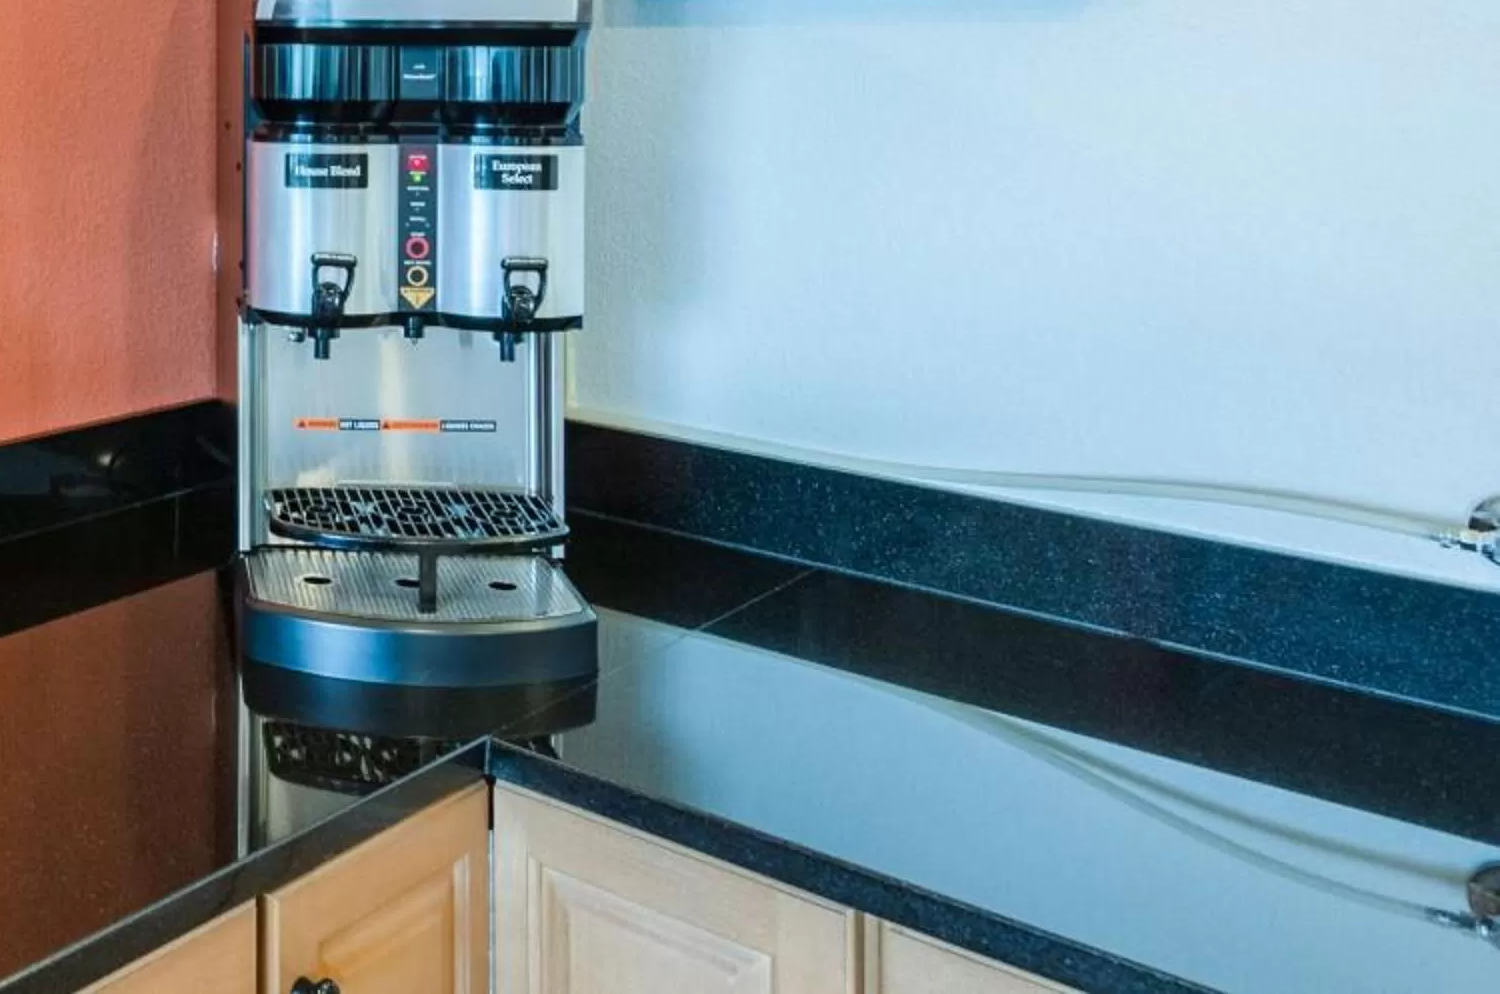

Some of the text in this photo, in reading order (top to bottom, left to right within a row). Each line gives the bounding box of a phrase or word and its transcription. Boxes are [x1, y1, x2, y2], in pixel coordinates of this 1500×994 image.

[330, 164, 361, 177] Blend
[492, 159, 543, 174] European
[501, 172, 533, 185] Select
